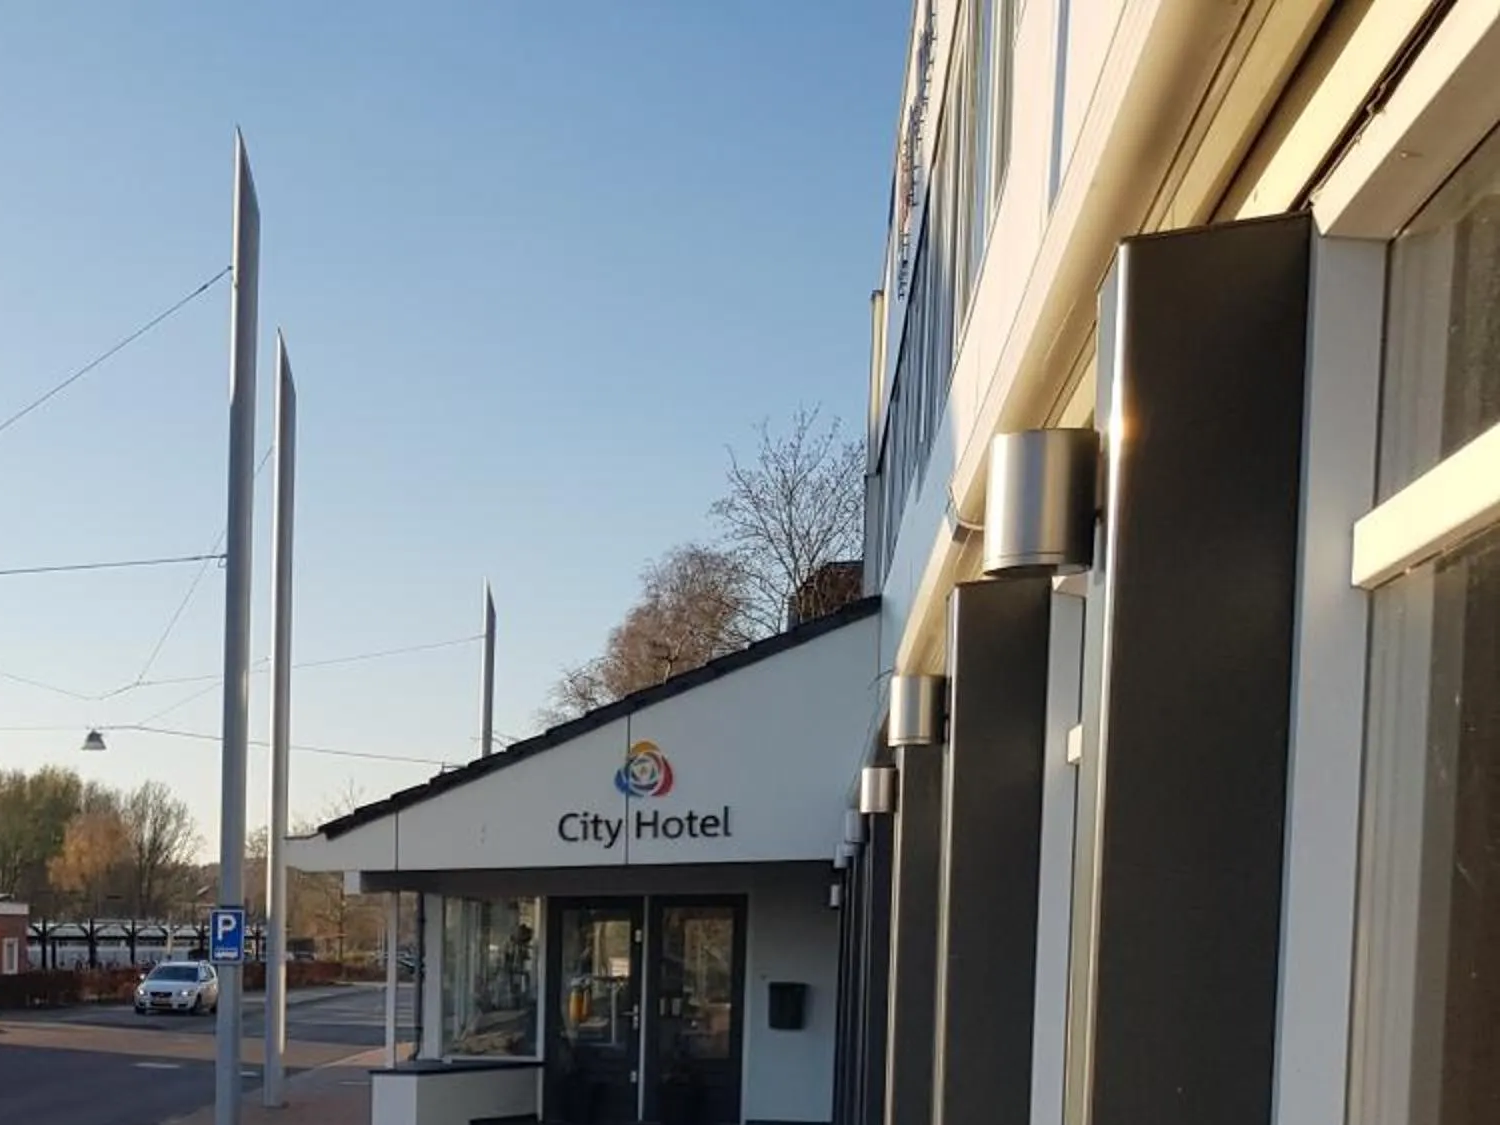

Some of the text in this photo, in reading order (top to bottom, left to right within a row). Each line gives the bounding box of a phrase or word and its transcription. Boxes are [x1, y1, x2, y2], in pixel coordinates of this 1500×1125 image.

[558, 805, 731, 849] City Hotel
[217, 914, 237, 941] P
